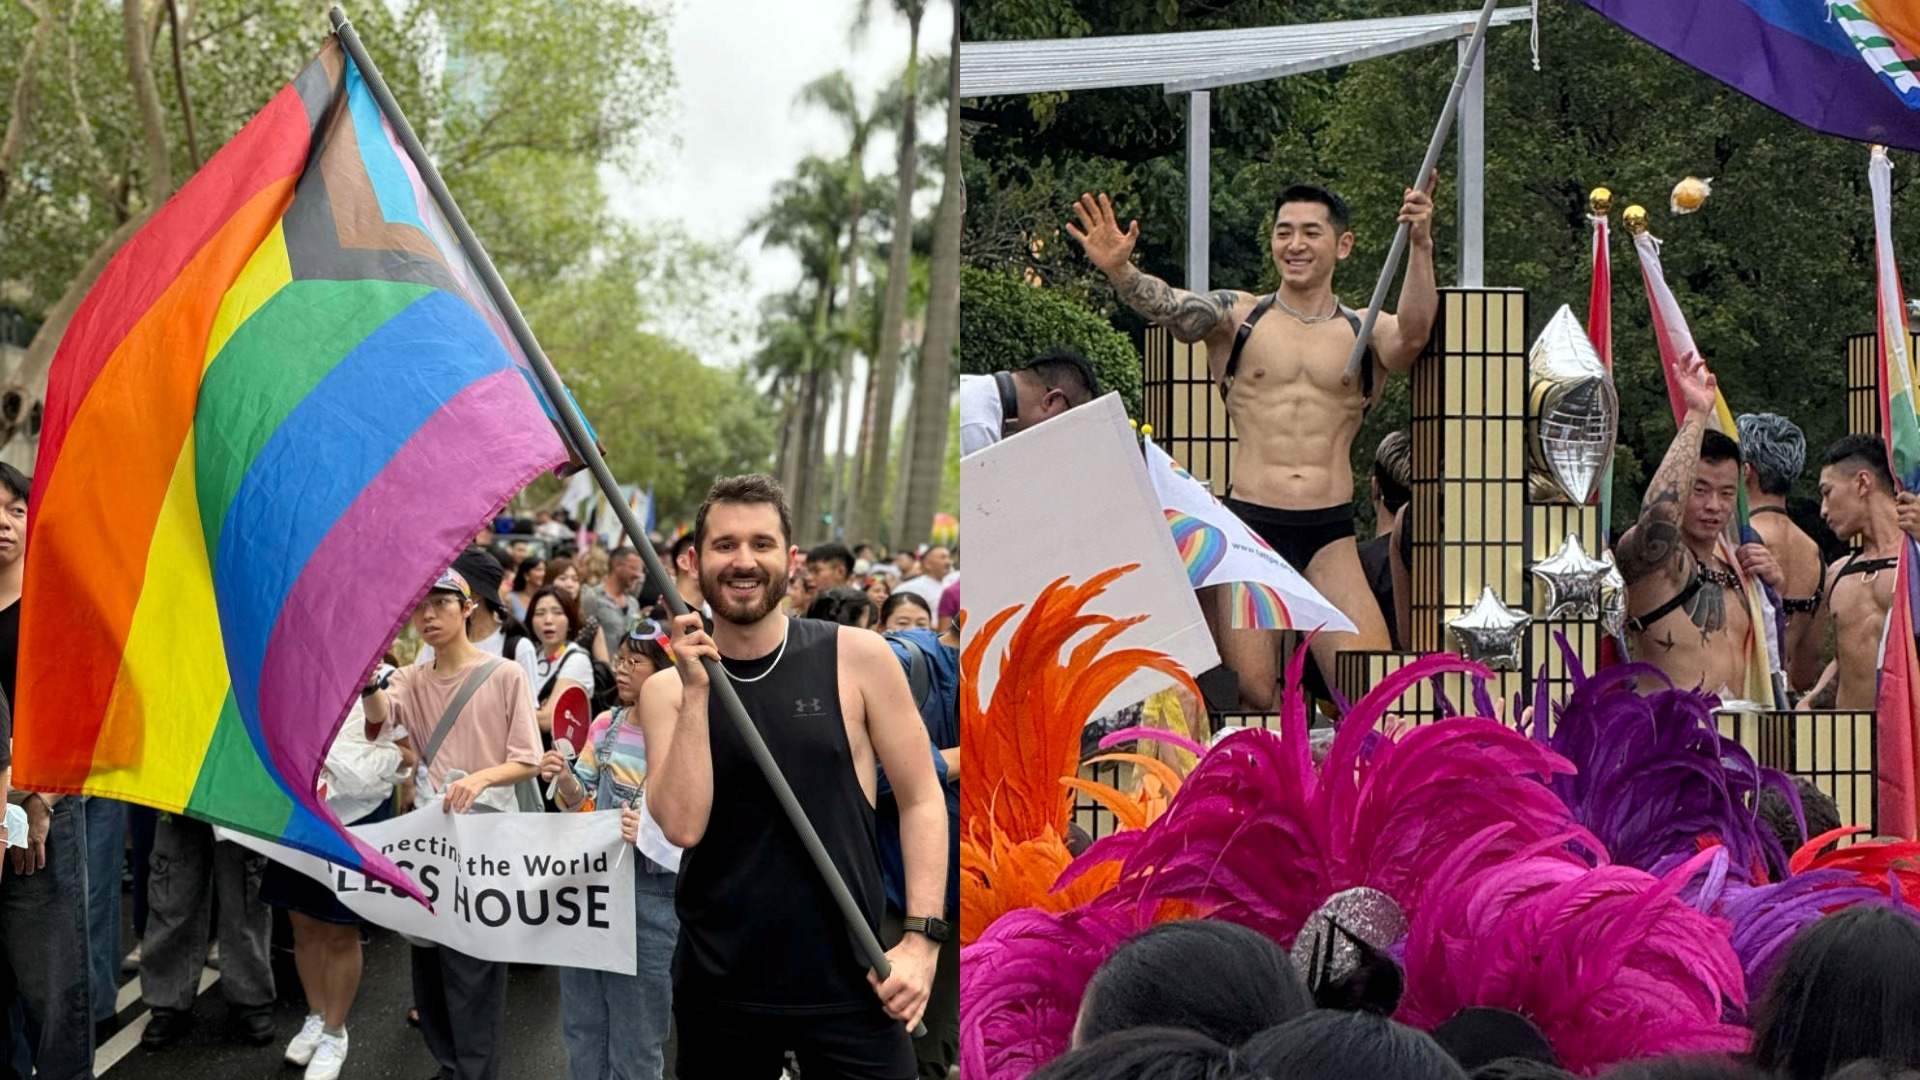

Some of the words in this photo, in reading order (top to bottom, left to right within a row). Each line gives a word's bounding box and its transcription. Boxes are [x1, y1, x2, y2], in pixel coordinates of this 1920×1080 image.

[466, 854, 511, 876] the
[523, 851, 608, 877] World
[454, 875, 610, 929] HOUSE
